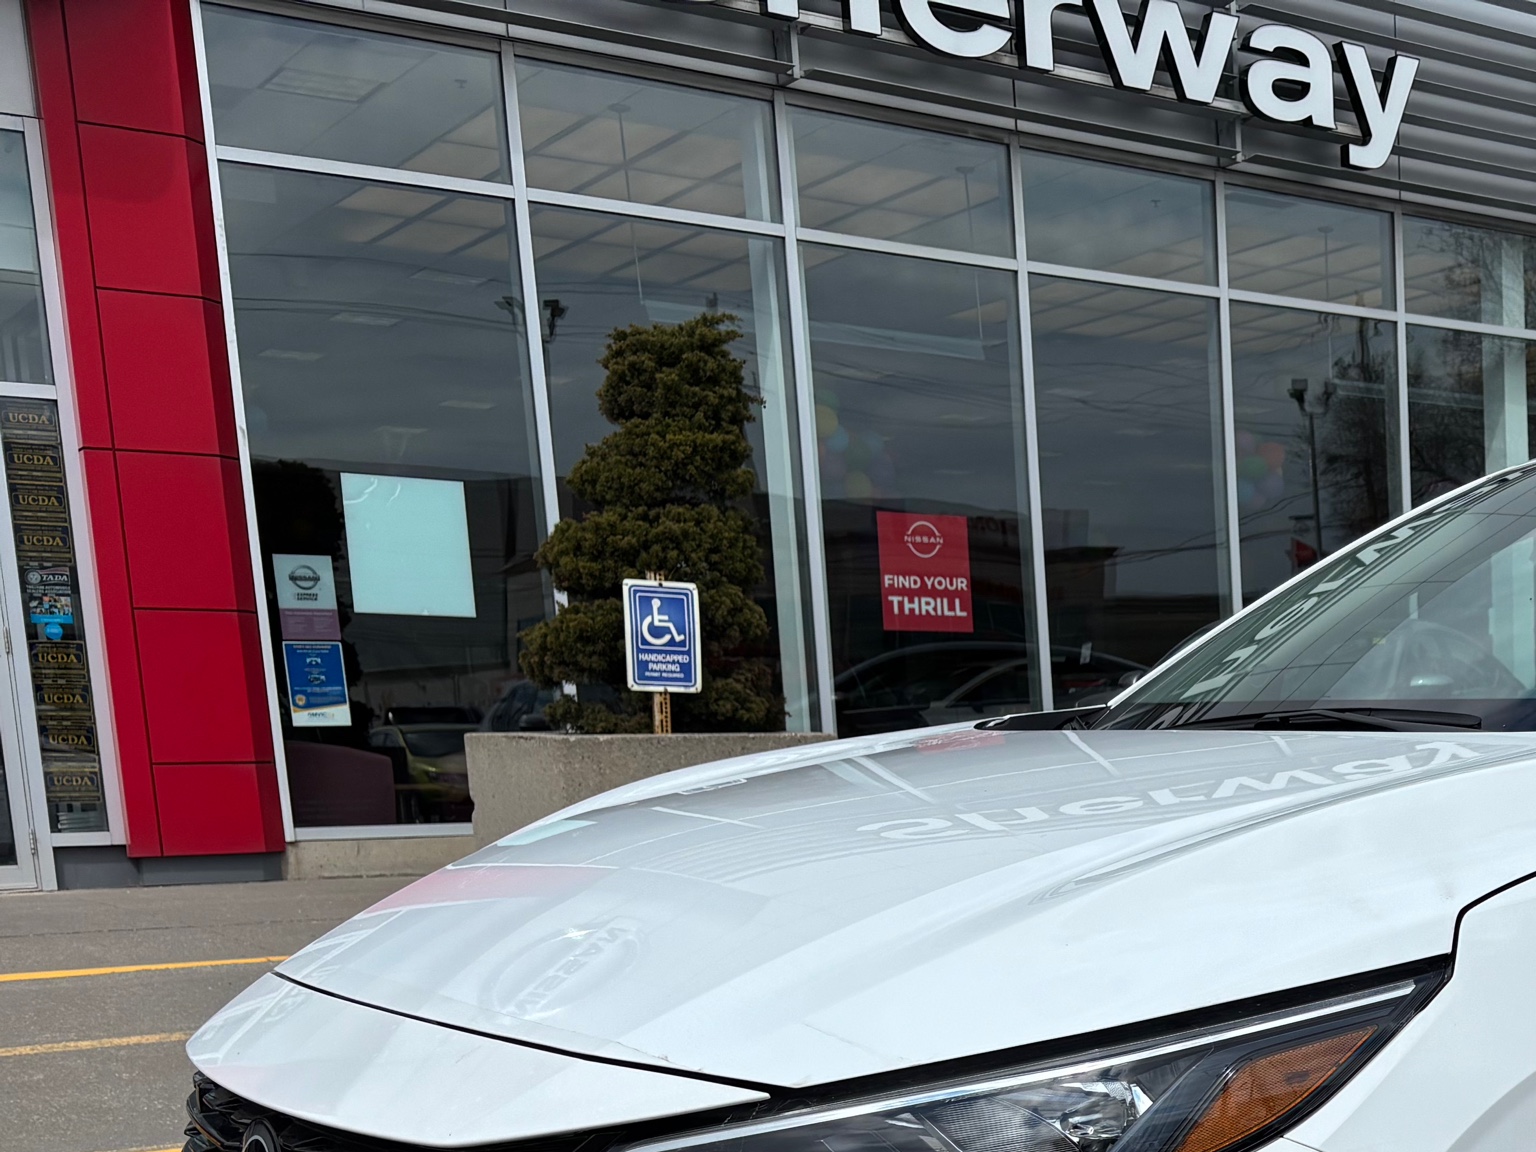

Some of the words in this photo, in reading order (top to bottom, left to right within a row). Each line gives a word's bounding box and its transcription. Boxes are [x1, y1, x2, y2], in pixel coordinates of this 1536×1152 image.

[762, 0, 1421, 169] erway
[8, 412, 49, 424] UCDA
[13, 453, 54, 465] UCDA
[18, 494, 59, 506] UCDA
[23, 534, 63, 547] UCDA
[904, 535, 944, 544] NISSAN
[41, 574, 68, 582] TADA
[884, 574, 921, 589] FIND
[924, 576, 968, 591] YOUR
[888, 595, 968, 617] THRILL
[38, 652, 78, 664] UCDA
[639, 653, 690, 664] HANDICAPPED
[648, 663, 681, 672] PARKING
[43, 692, 84, 704] UCDA
[49, 734, 88, 746] UCDA
[53, 775, 92, 787] UCDA
